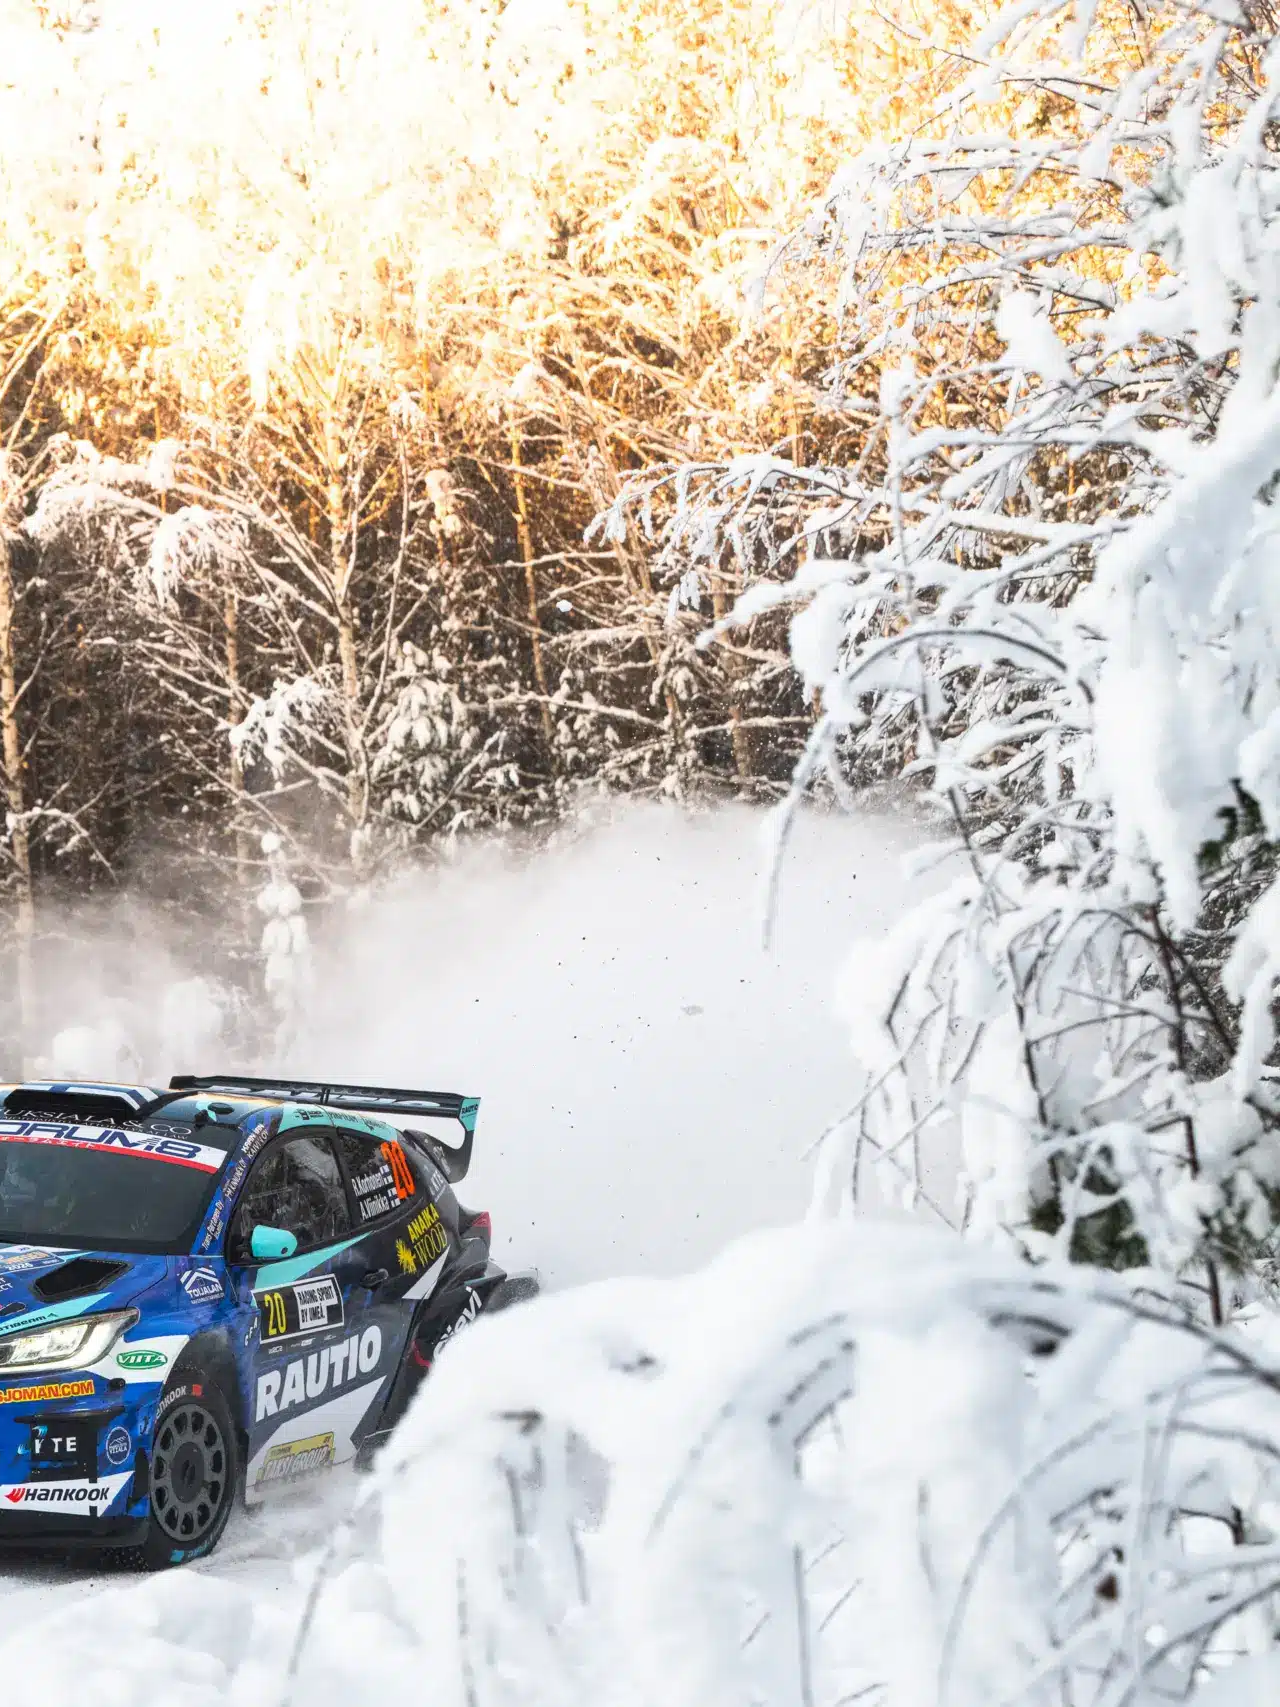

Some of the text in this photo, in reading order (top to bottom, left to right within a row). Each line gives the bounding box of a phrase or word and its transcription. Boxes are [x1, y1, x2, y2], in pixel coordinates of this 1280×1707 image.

[123, 1119, 146, 1130] &
[150, 1123, 192, 1136] CO
[380, 1139, 416, 1200] 20
[351, 1170, 384, 1197] R.Korhonen
[359, 1193, 390, 1221] A.Viinikka
[407, 1202, 440, 1243] ANAIKA
[413, 1222, 448, 1267] WOOD
[187, 1284, 223, 1299] TOIJALAN
[297, 1285, 335, 1305] RACING SPIRIT
[263, 1292, 287, 1336] 20
[300, 1309, 308, 1323] BY
[118, 1354, 167, 1366] VIITA
[255, 1325, 382, 1423] RAUTIO
